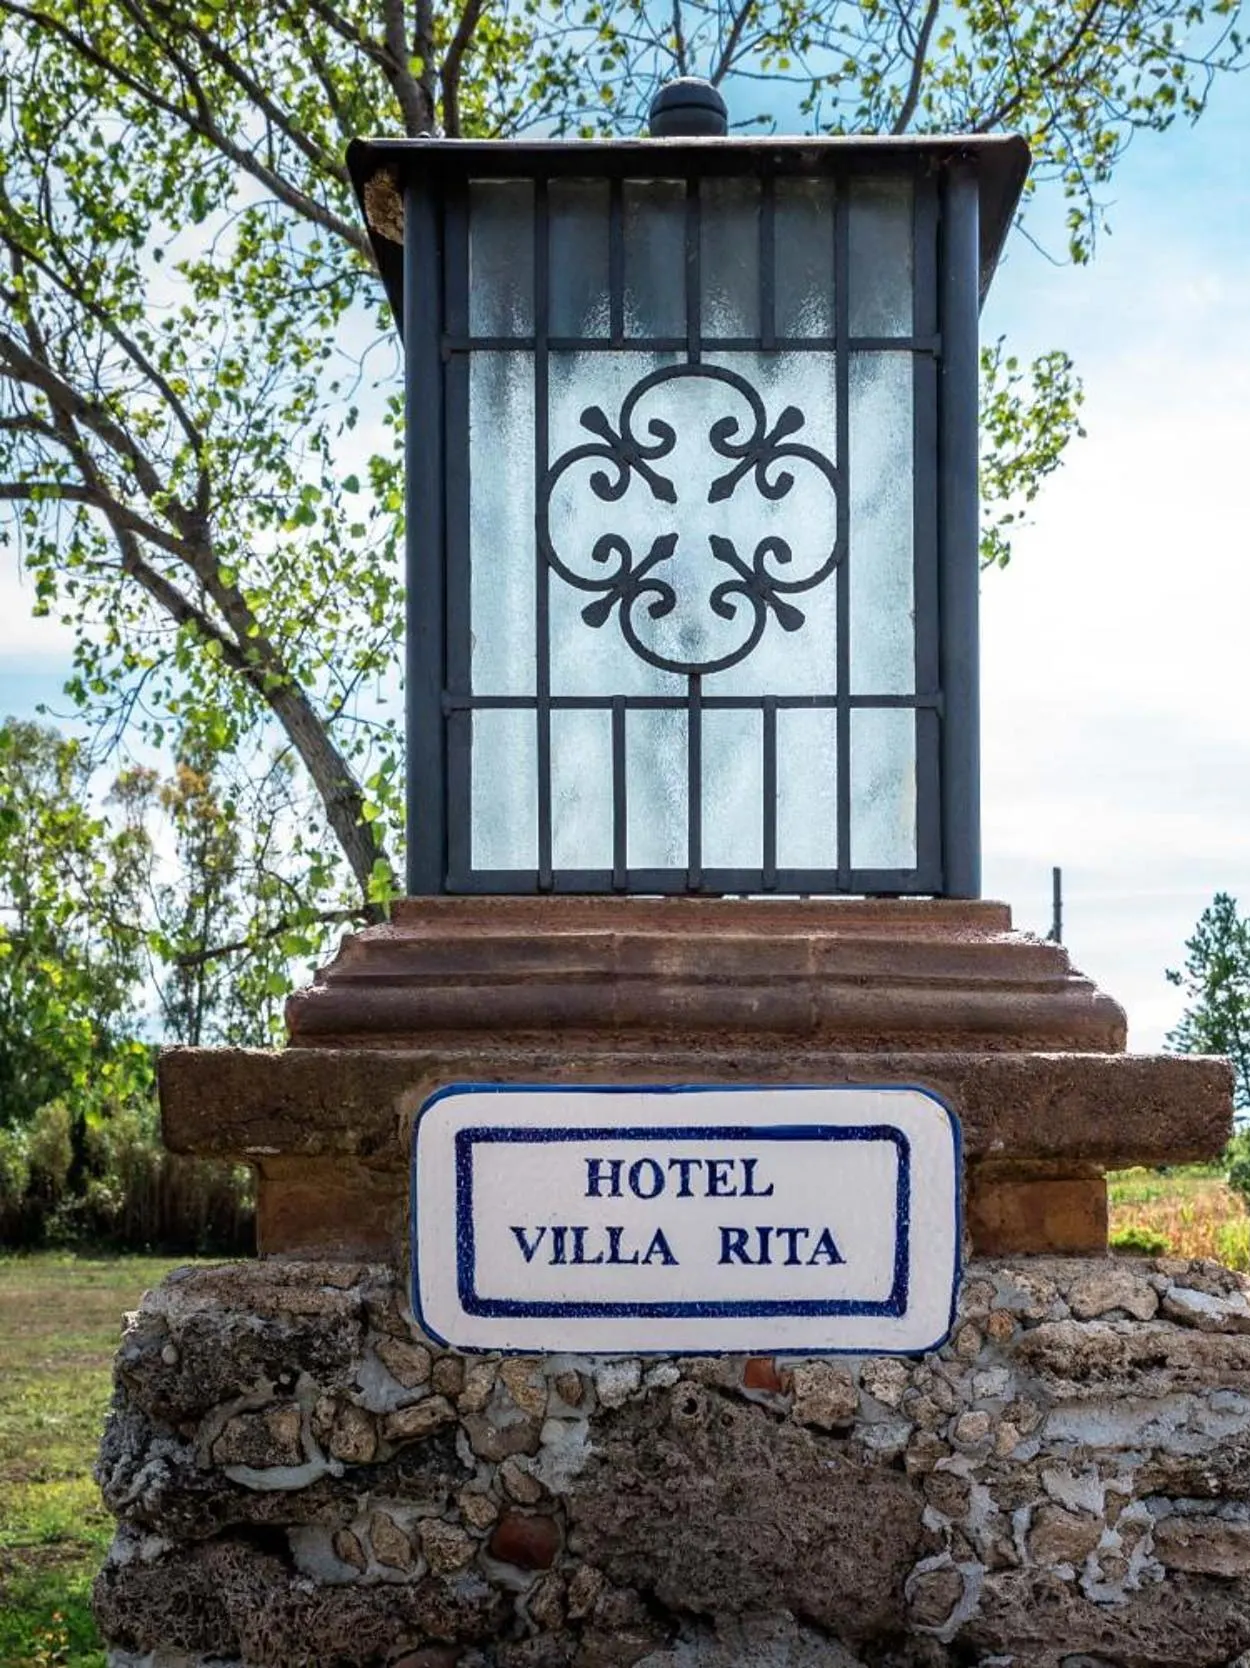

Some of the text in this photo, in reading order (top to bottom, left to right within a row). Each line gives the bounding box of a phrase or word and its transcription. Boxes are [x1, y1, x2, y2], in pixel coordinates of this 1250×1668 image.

[584, 1157, 775, 1200] HOTEL
[509, 1225, 847, 1266] VILLA RITA
